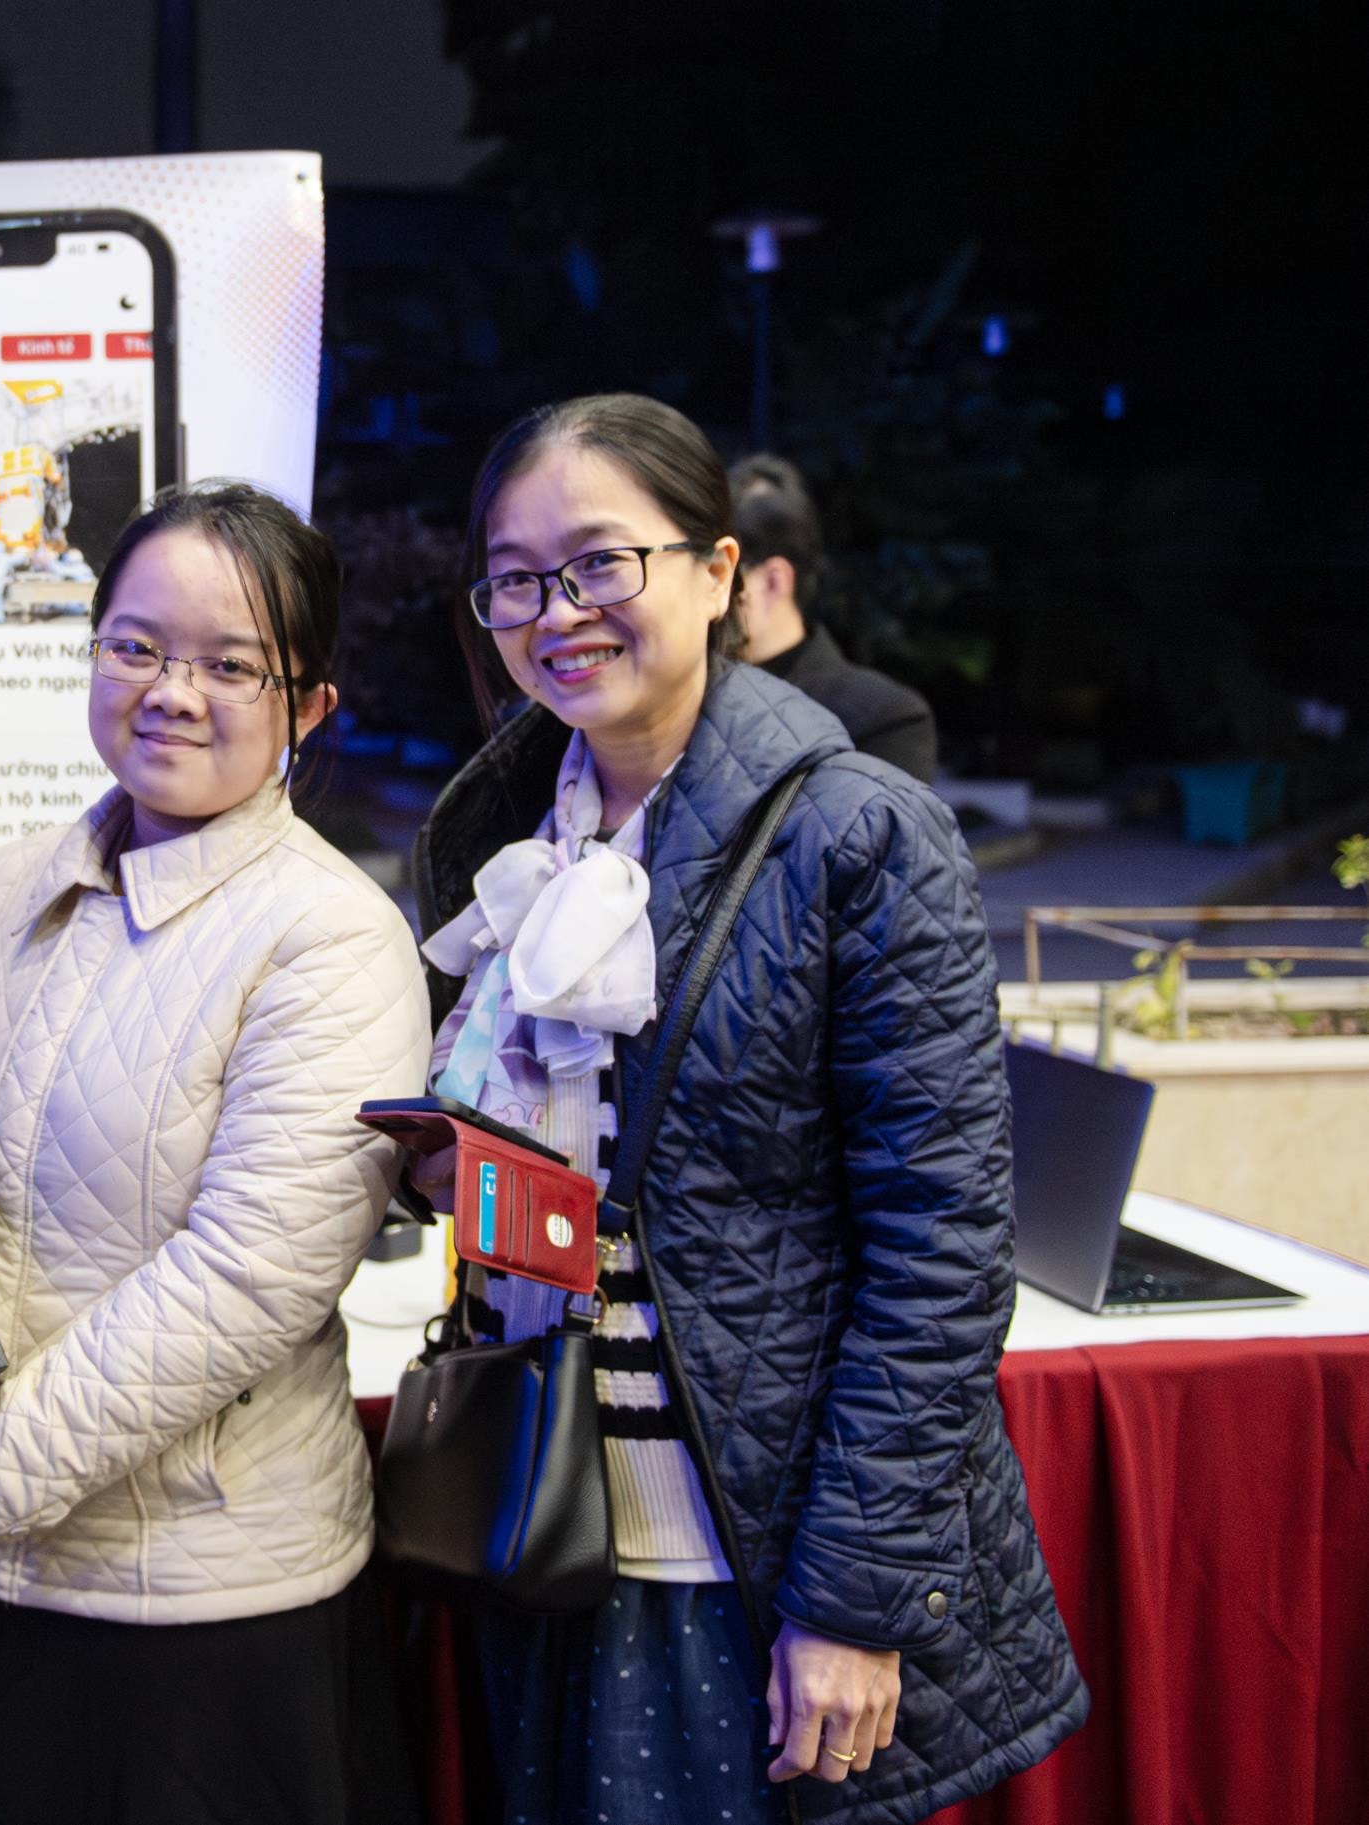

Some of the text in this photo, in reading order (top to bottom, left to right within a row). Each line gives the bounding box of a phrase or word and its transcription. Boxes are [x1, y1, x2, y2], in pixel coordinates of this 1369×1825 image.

[17, 340, 52, 356] Kinh
[12, 642, 52, 662] Việt
[39, 676, 90, 694] ngạc
[66, 761, 109, 779] chịu
[8, 791, 34, 811] hộ
[41, 791, 83, 807] kinh
